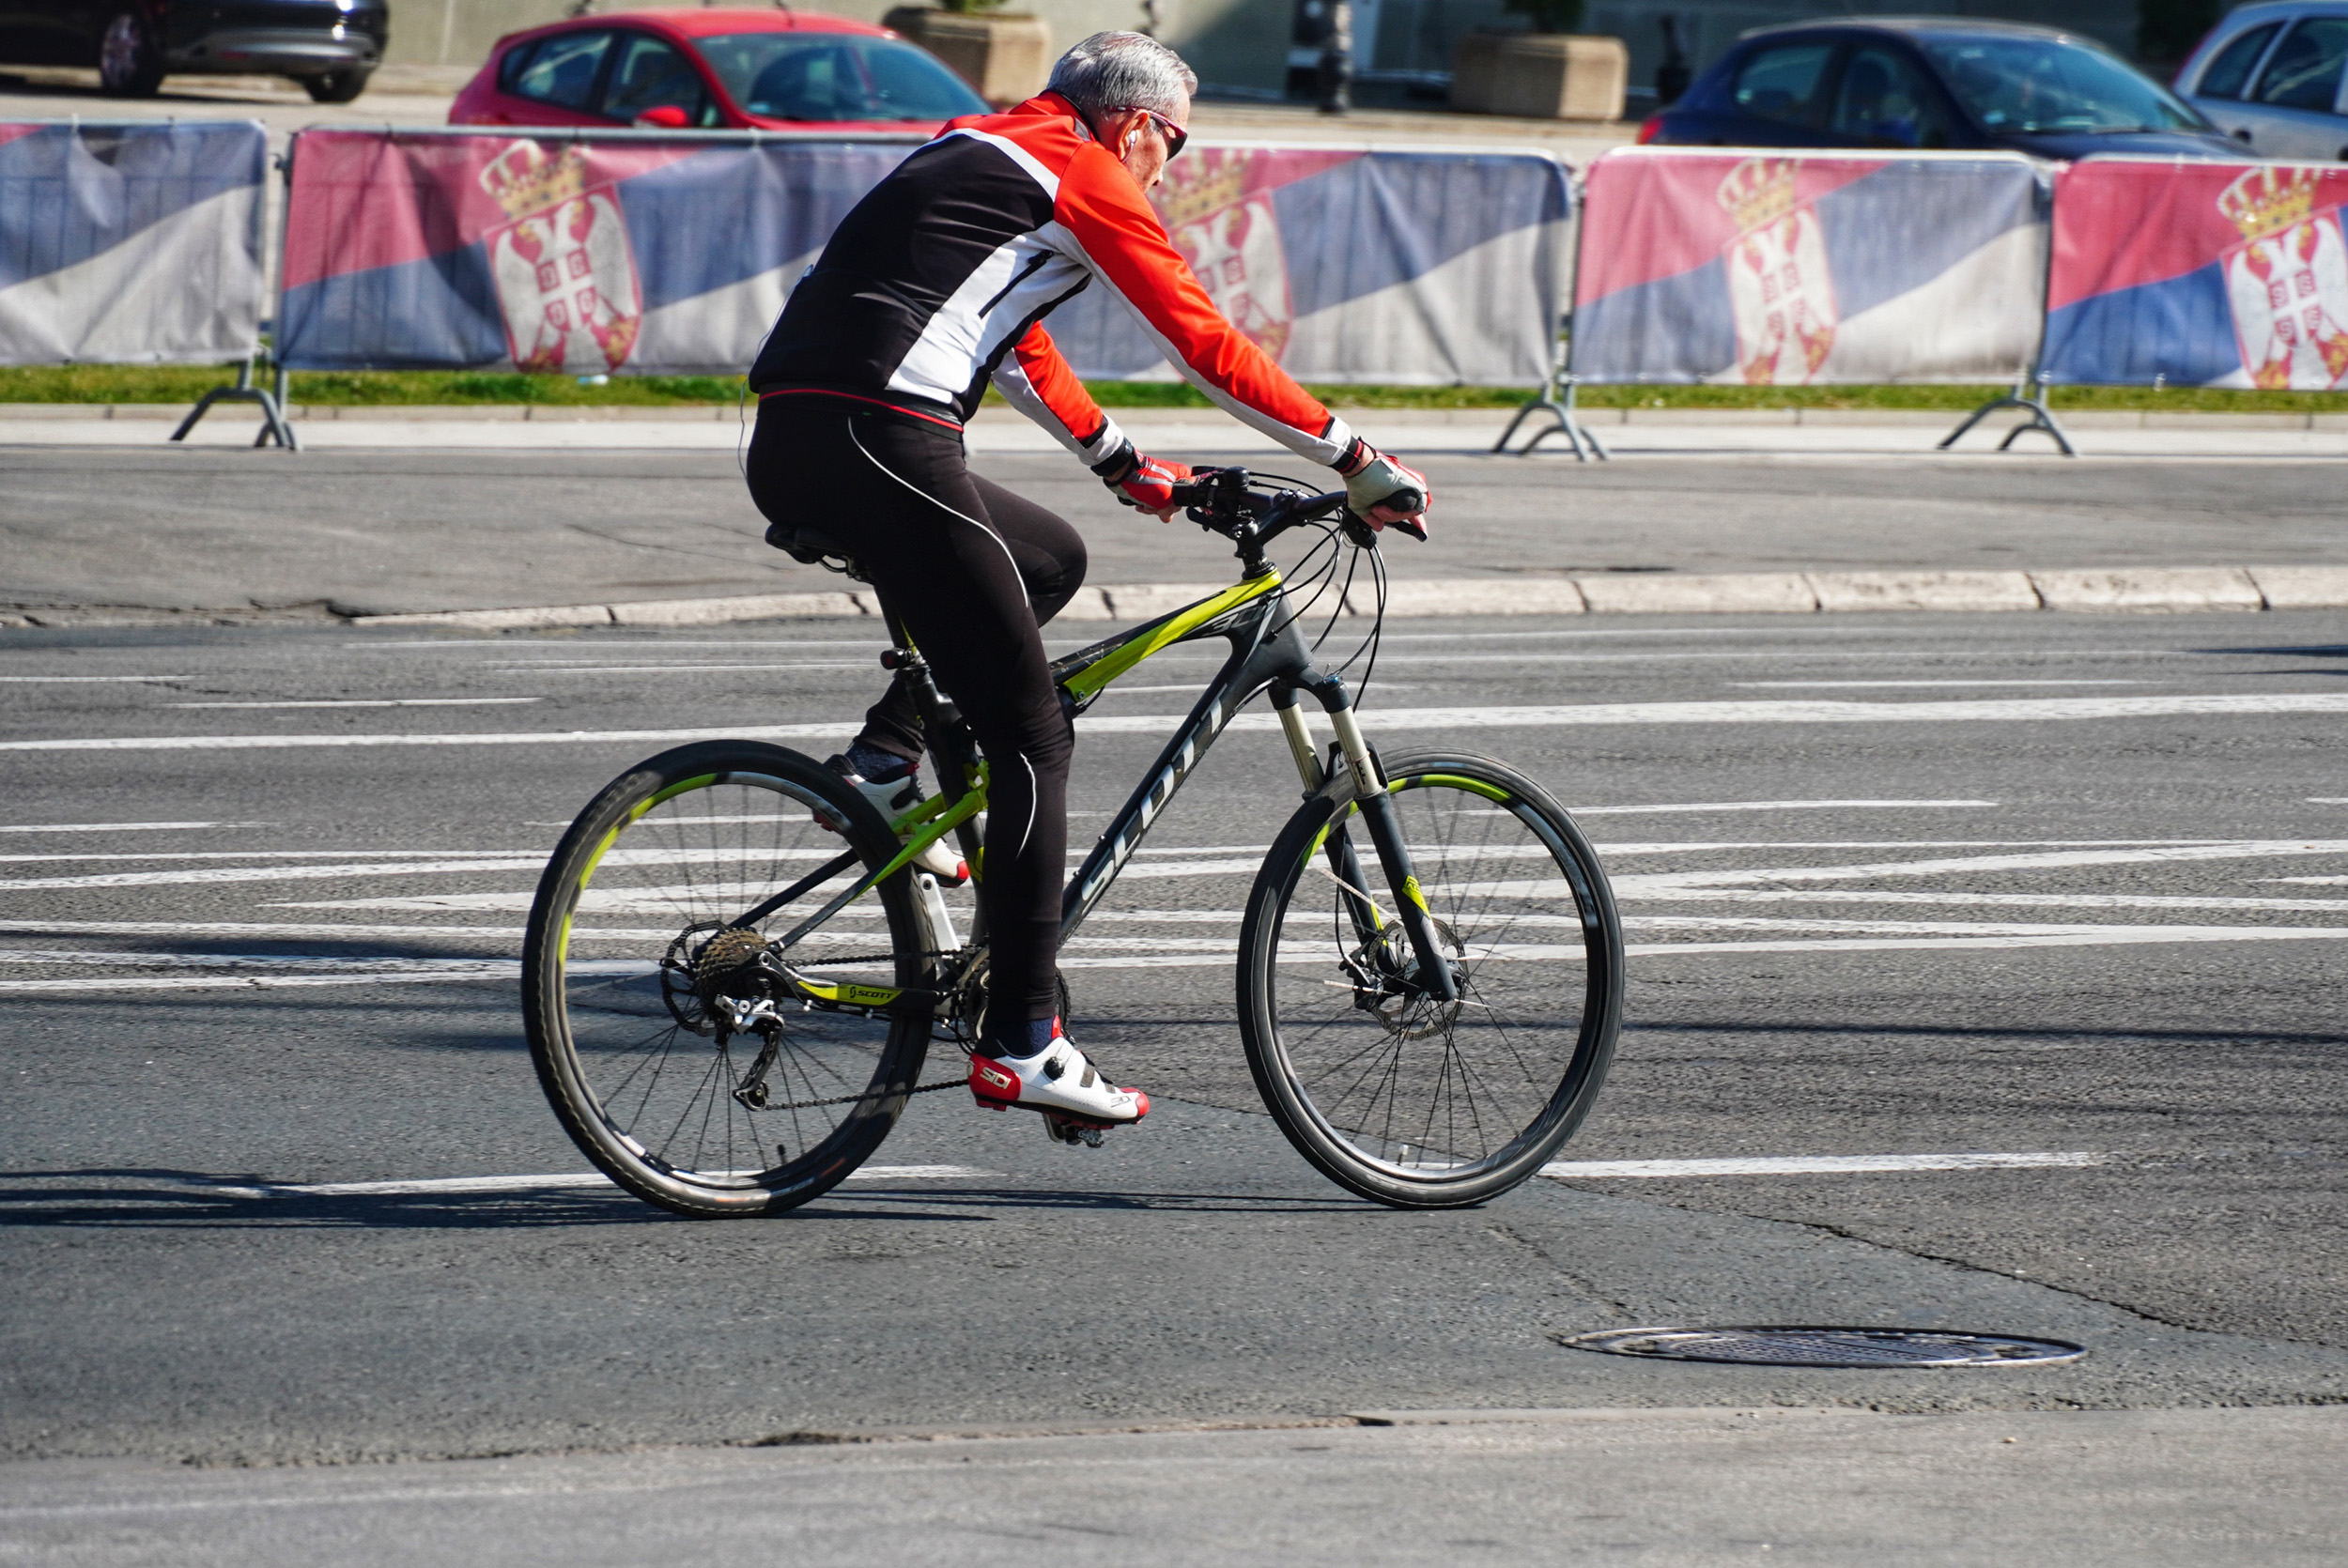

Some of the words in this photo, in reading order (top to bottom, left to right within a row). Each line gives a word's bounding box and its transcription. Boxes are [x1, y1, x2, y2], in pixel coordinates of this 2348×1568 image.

[1081, 683, 1228, 915] SCOTT
[857, 990, 893, 998] SCOTT
[980, 1067, 1012, 1089] SIDI
